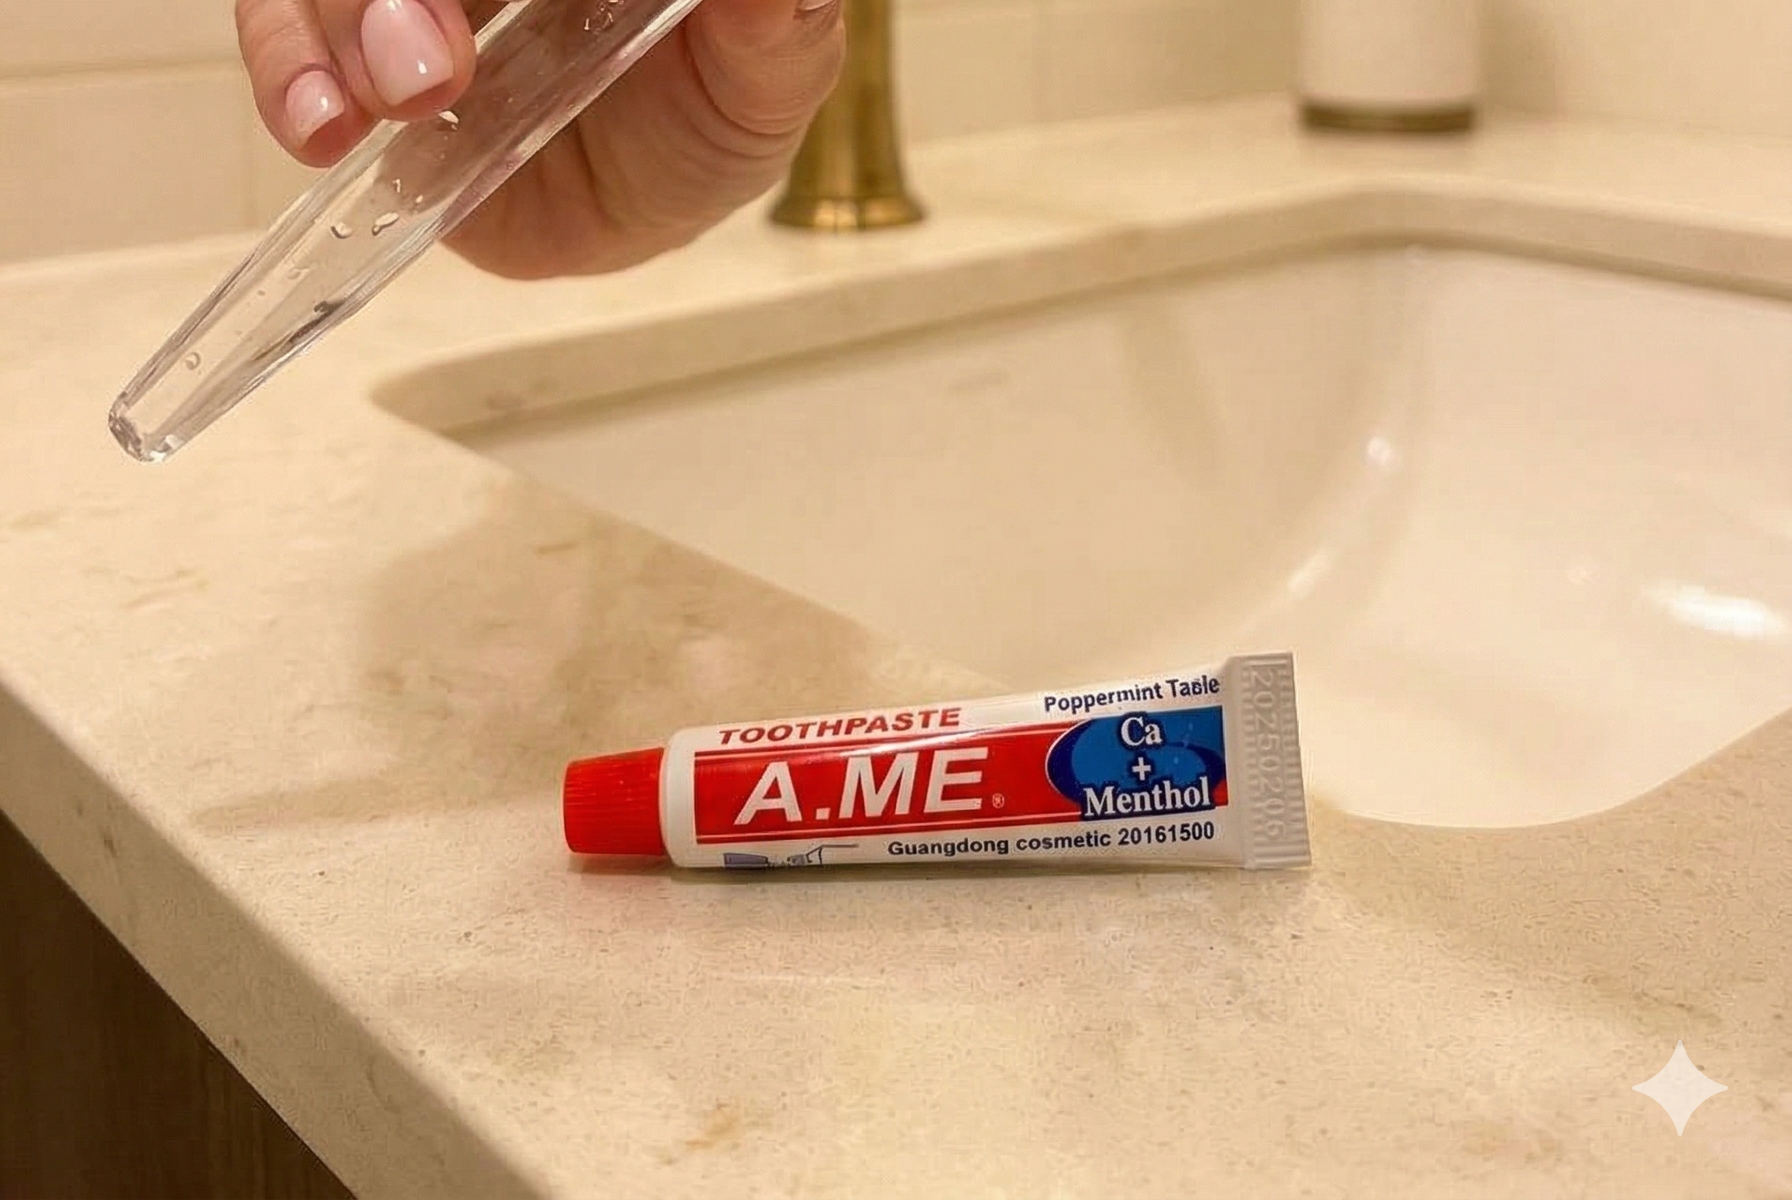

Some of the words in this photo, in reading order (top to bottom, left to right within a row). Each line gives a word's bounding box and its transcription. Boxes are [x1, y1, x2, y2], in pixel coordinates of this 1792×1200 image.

[719, 706, 962, 745] TOOTHPASTE
[1120, 716, 1163, 747] Ca
[1251, 668, 1288, 839] 20250206
[733, 746, 989, 826] A.ME
[1082, 775, 1211, 817] Menthol
[887, 837, 1009, 857] Guangdong
[1015, 830, 1112, 851] cosmetic
[1117, 820, 1215, 846] 20161500
